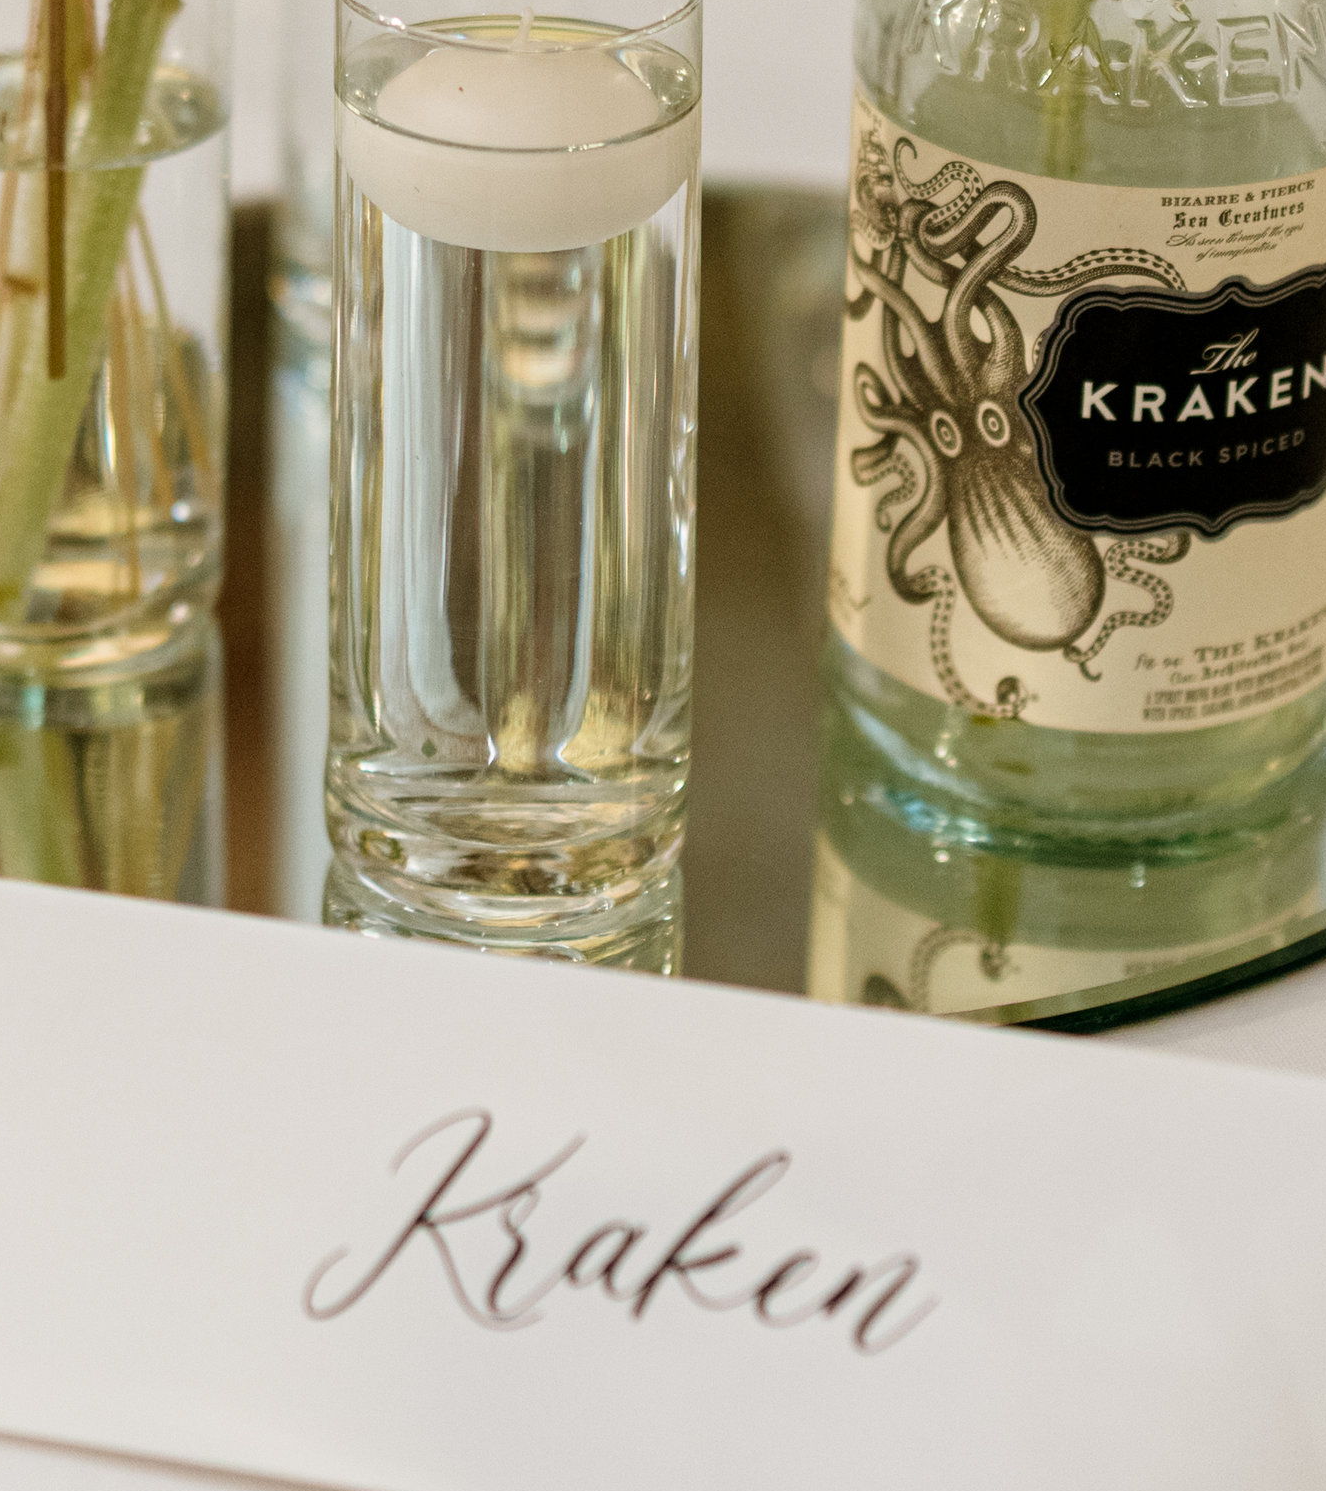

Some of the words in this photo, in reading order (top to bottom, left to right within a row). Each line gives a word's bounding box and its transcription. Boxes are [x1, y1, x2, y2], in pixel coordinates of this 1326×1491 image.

[1161, 194, 1240, 207] BIZARRE
[1245, 192, 1255, 202] &
[1261, 179, 1316, 200] FIERCE
[1173, 211, 1208, 230] Sea
[1218, 201, 1305, 227] Creatures
[1189, 327, 1260, 375] The
[1108, 450, 1204, 468] BLACK
[1219, 428, 1306, 464] SPICED
[301, 1105, 942, 1357] Kraken
